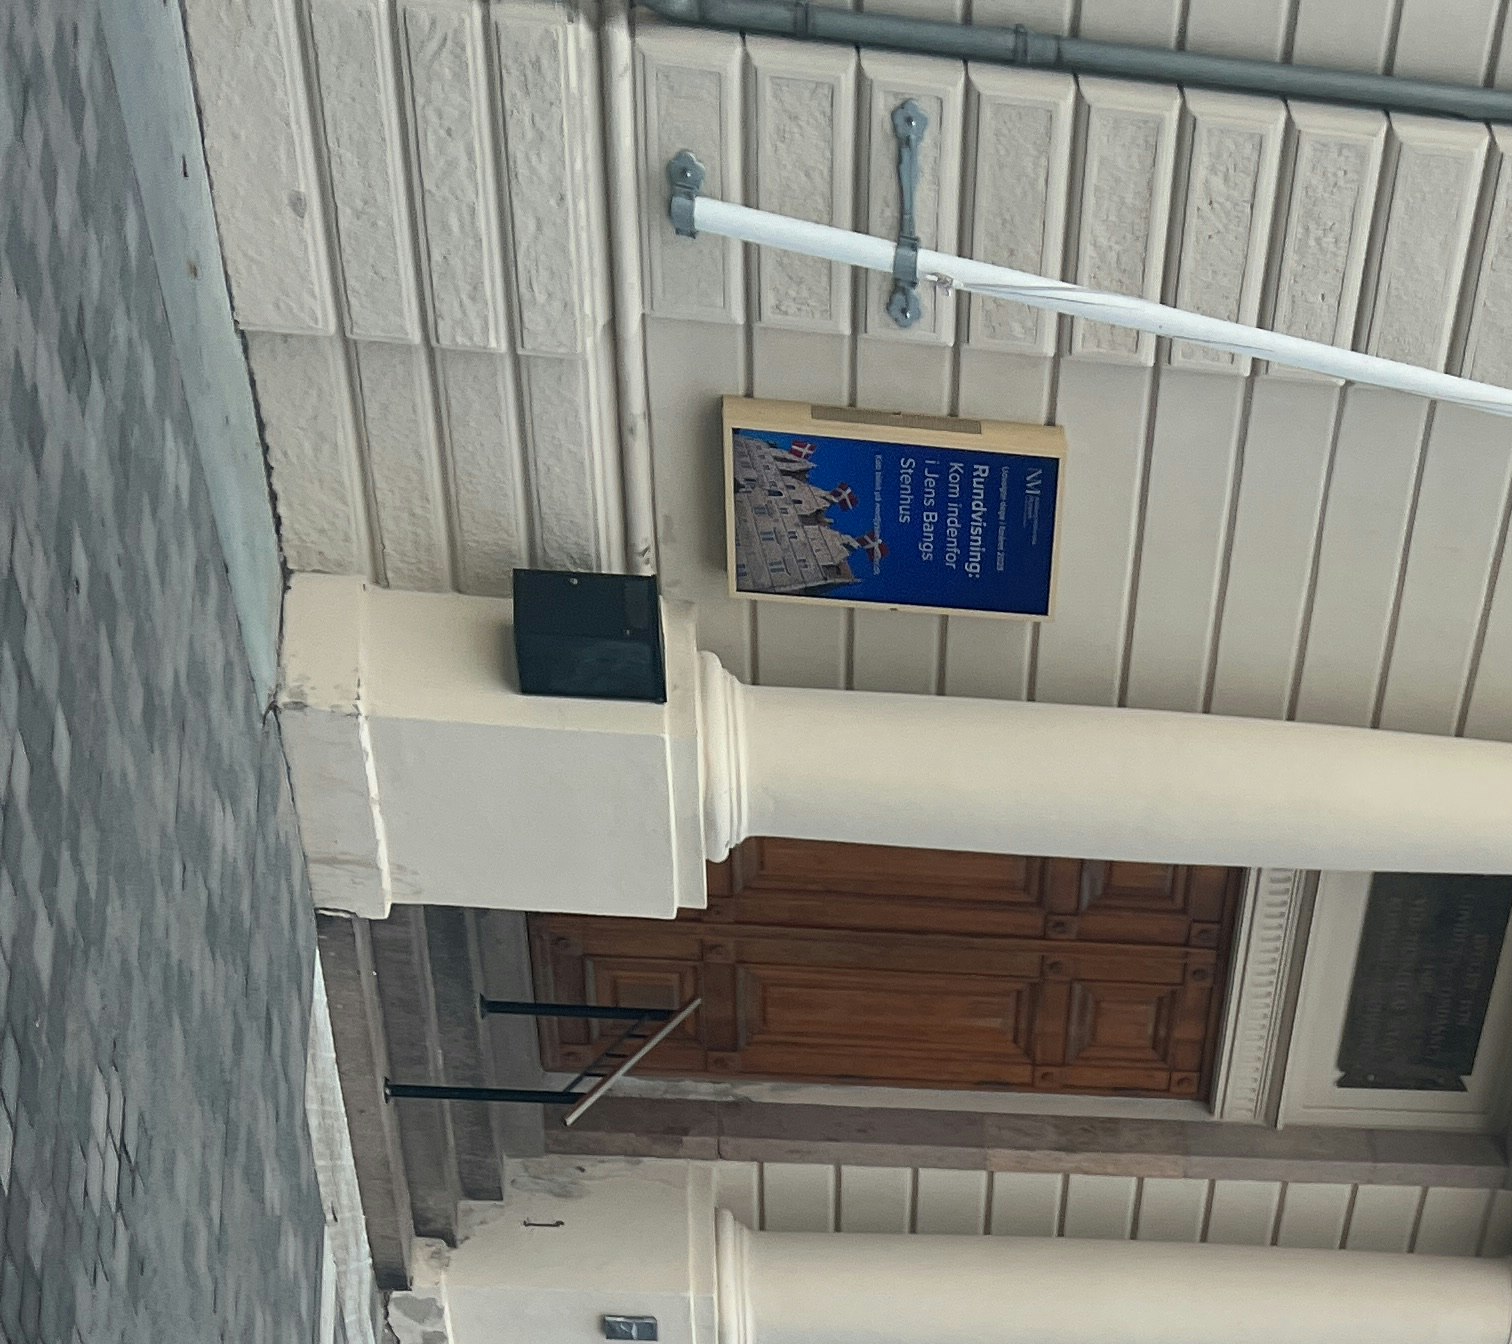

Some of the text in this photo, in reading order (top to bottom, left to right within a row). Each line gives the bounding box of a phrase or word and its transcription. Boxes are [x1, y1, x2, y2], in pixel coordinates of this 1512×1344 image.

[899, 457, 915, 524] Stenhus
[923, 467, 939, 507] Jens
[945, 462, 964, 570] Kom indenfor
[918, 511, 938, 561] Bangs
[965, 465, 990, 579] Rundvisning:
